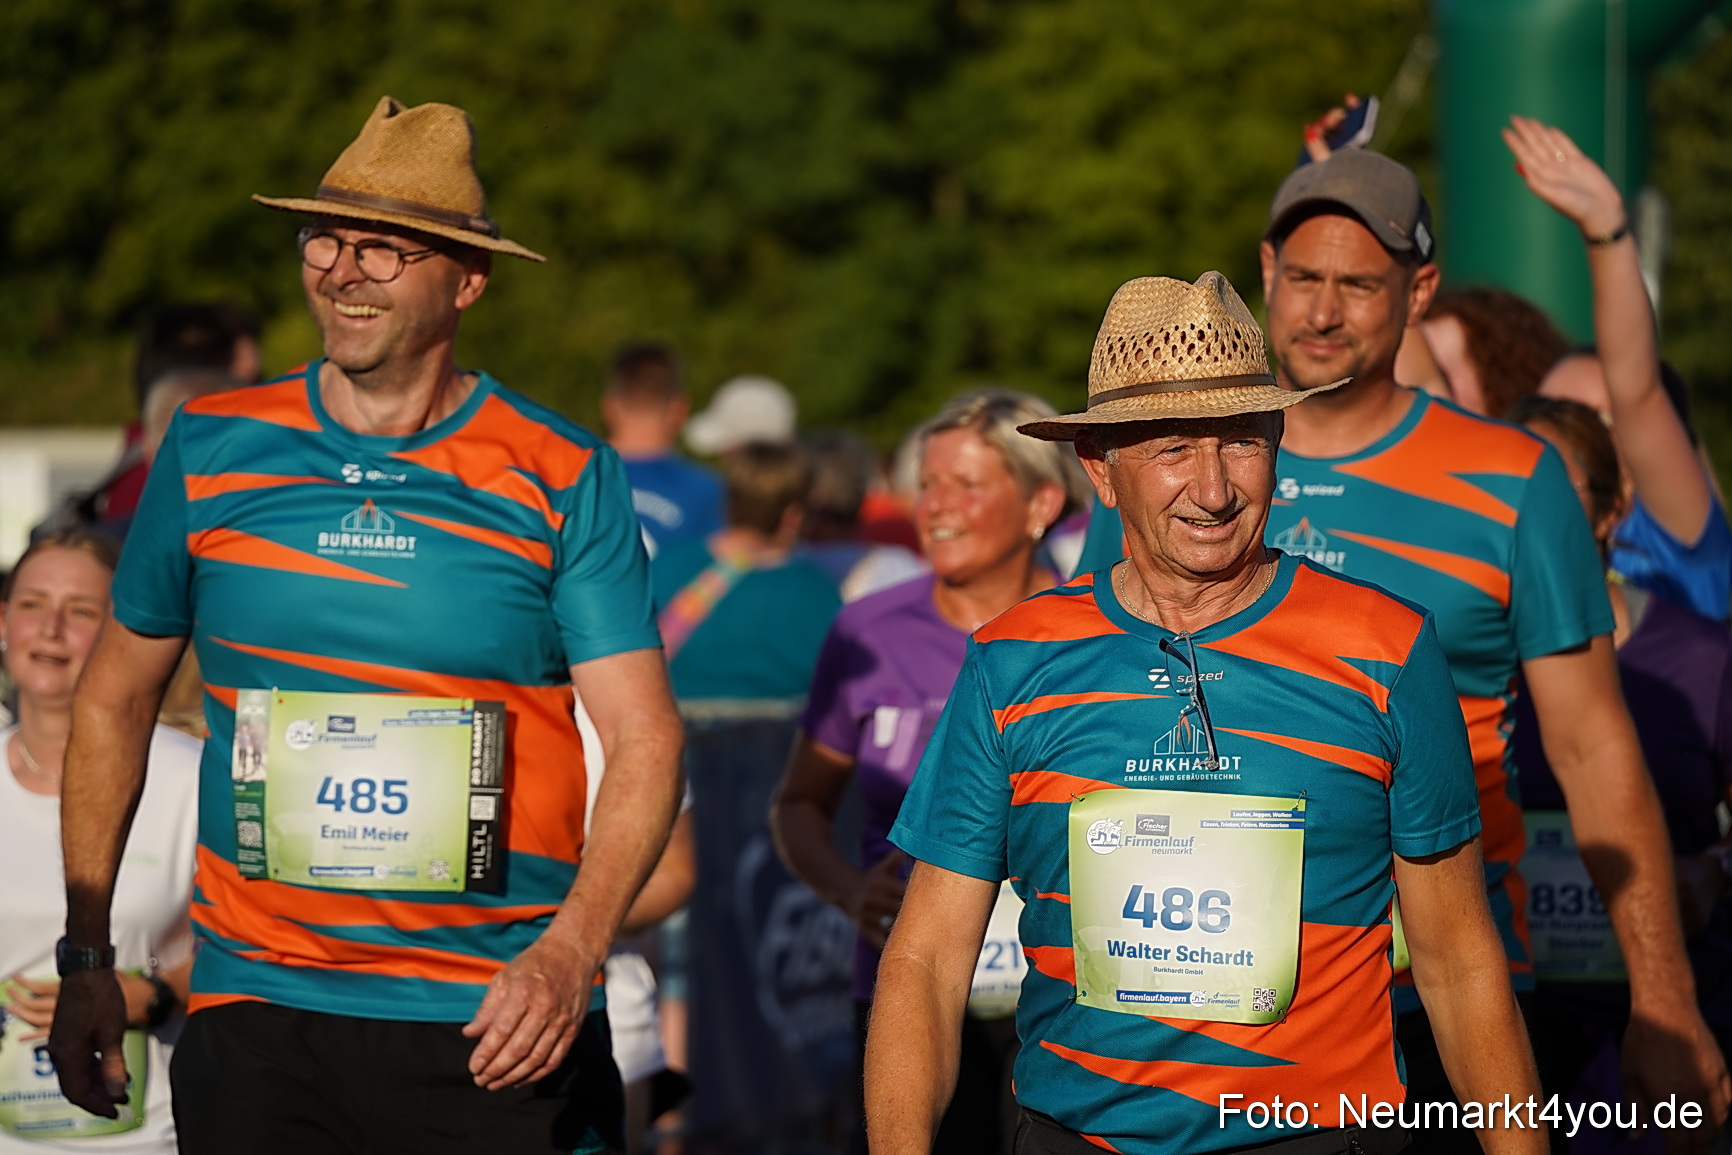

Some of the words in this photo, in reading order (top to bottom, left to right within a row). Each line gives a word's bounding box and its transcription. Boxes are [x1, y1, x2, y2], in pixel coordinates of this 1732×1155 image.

[317, 532, 417, 551] BURKHARDT
[1176, 669, 1225, 685] spzed
[1125, 756, 1241, 772] BURKHADT
[1176, 772, 1241, 780] GEBÄUDETECHNIK
[316, 776, 408, 815] 485
[1232, 811, 1251, 819] Laufen,
[1252, 811, 1272, 819] Joggen,
[1272, 811, 1292, 819] Walken
[1141, 820, 1168, 830] Fischer
[320, 824, 357, 839] Emil
[362, 827, 409, 842] Meier
[1124, 835, 1195, 848] Firmenlauf
[470, 823, 488, 879] HILTL
[1151, 847, 1193, 855] neumarkt
[1122, 884, 1232, 934] 486
[1107, 939, 1172, 961] Walter
[1175, 944, 1254, 967] Schardt
[1153, 966, 1184, 974] Burkhardt
[1119, 992, 1187, 1004] firmenlauf.bayern
[1207, 997, 1241, 1005] Firmenlauf
